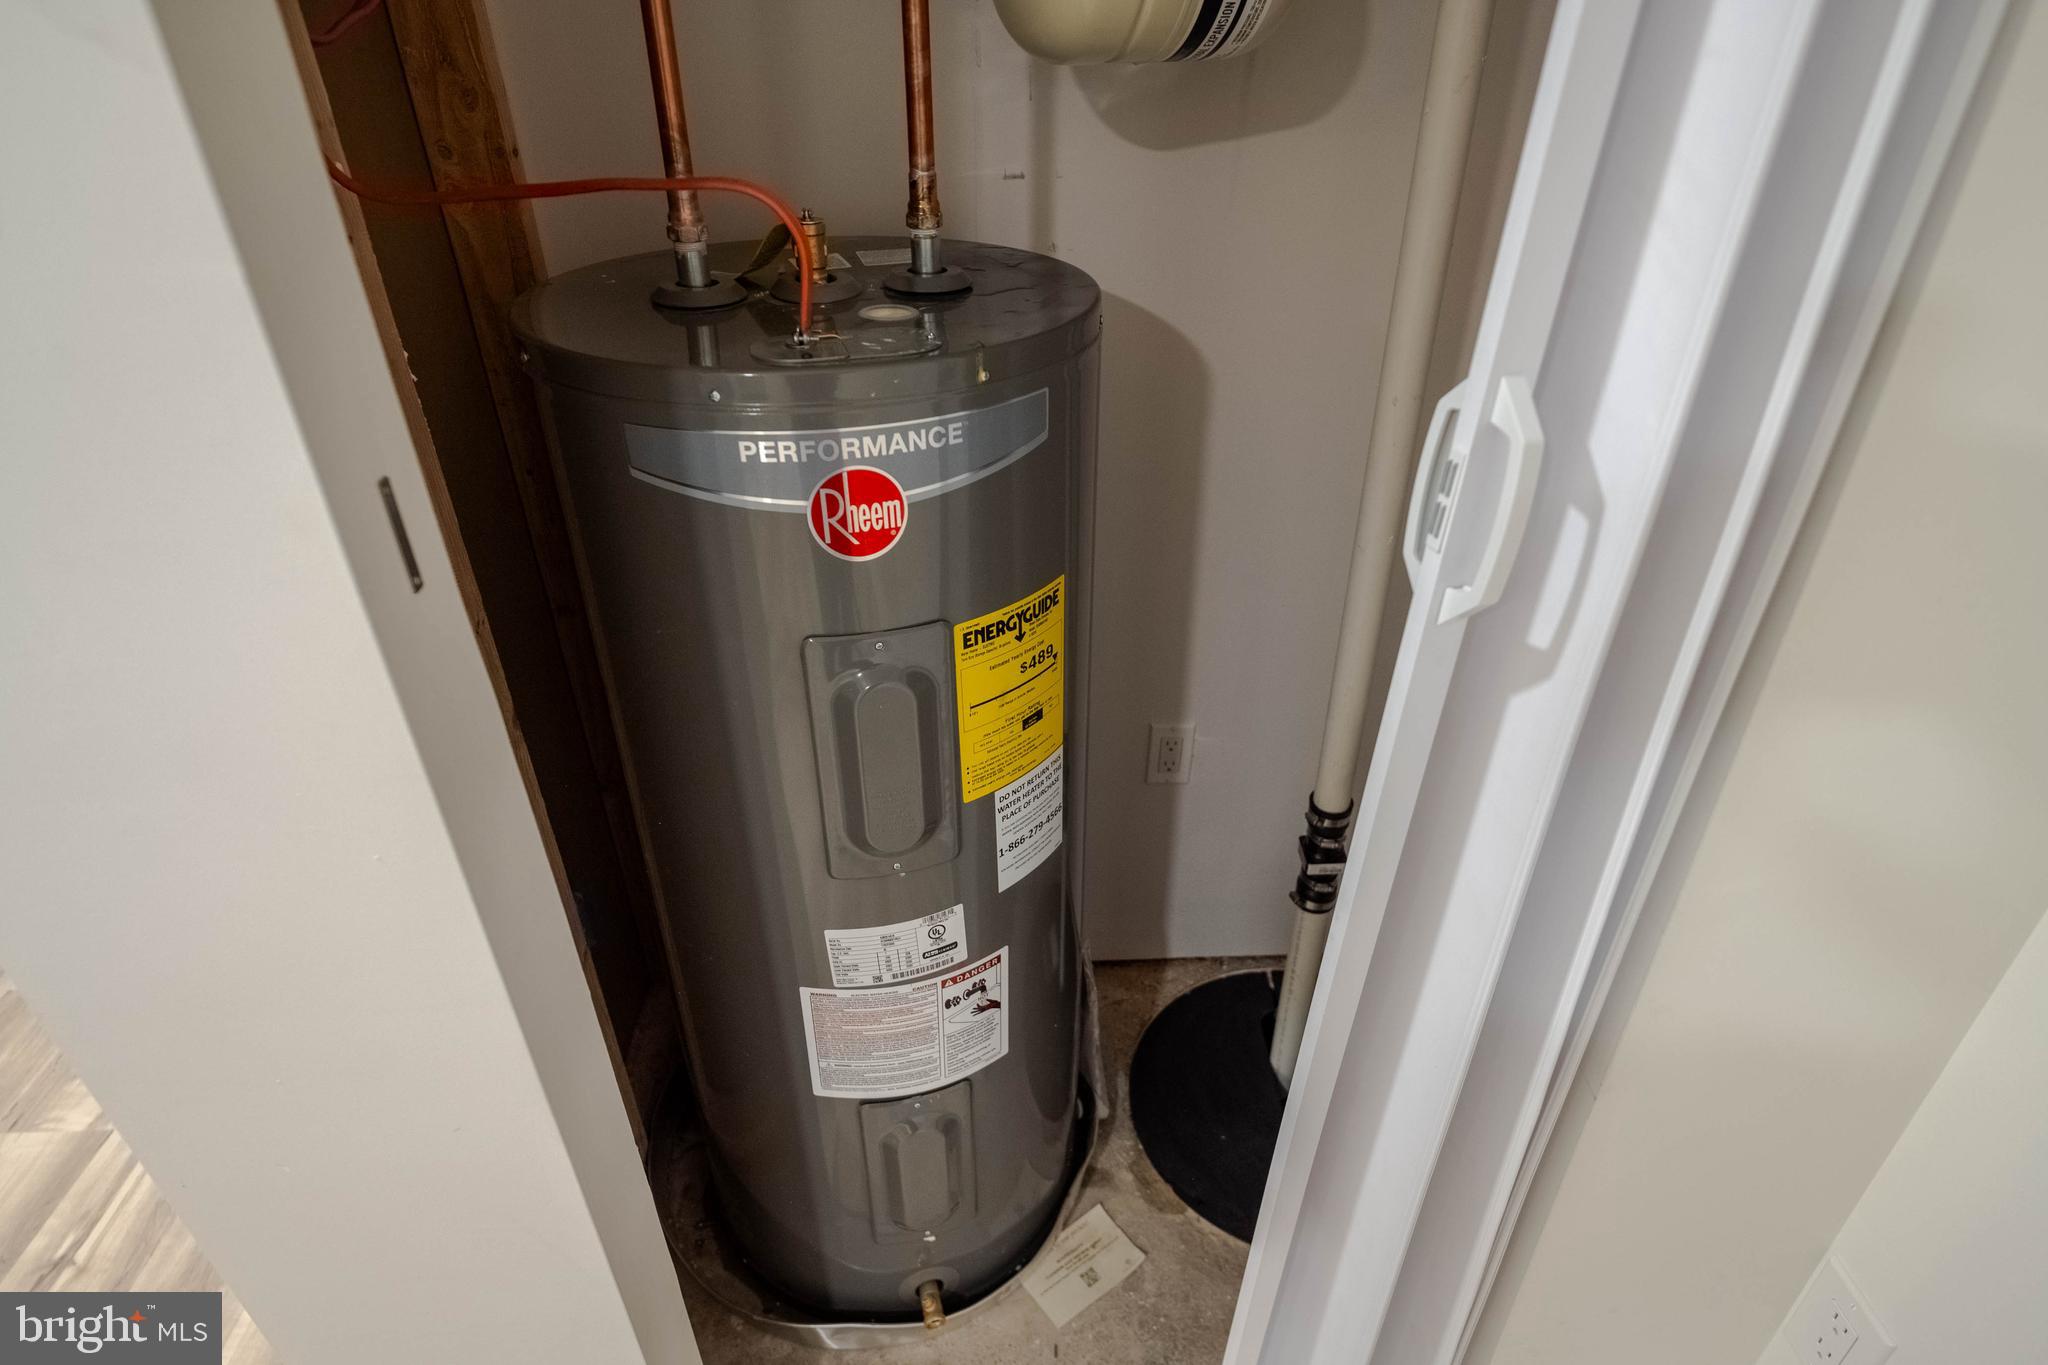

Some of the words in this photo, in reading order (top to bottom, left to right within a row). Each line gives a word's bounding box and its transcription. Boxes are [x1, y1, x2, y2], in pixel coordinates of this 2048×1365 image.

[1203, 1, 1236, 49] EXPANSION
[738, 422, 964, 463] PERFORMANCE
[819, 470, 901, 545] Rheem
[962, 588, 1060, 650] ENERGYGUIDE
[1020, 643, 1054, 674] $489
[997, 796, 1021, 814] WATER
[1022, 780, 1045, 800] HEATER
[1045, 772, 1053, 782] TO
[999, 792, 1010, 803] DO
[1012, 784, 1026, 797] NOT
[1027, 765, 1050, 786] RETURN
[1001, 806, 1022, 822] PLACE
[1023, 799, 1032, 809] OF
[1032, 774, 1060, 803] PURCHASE
[956, 958, 998, 982] DANGER
